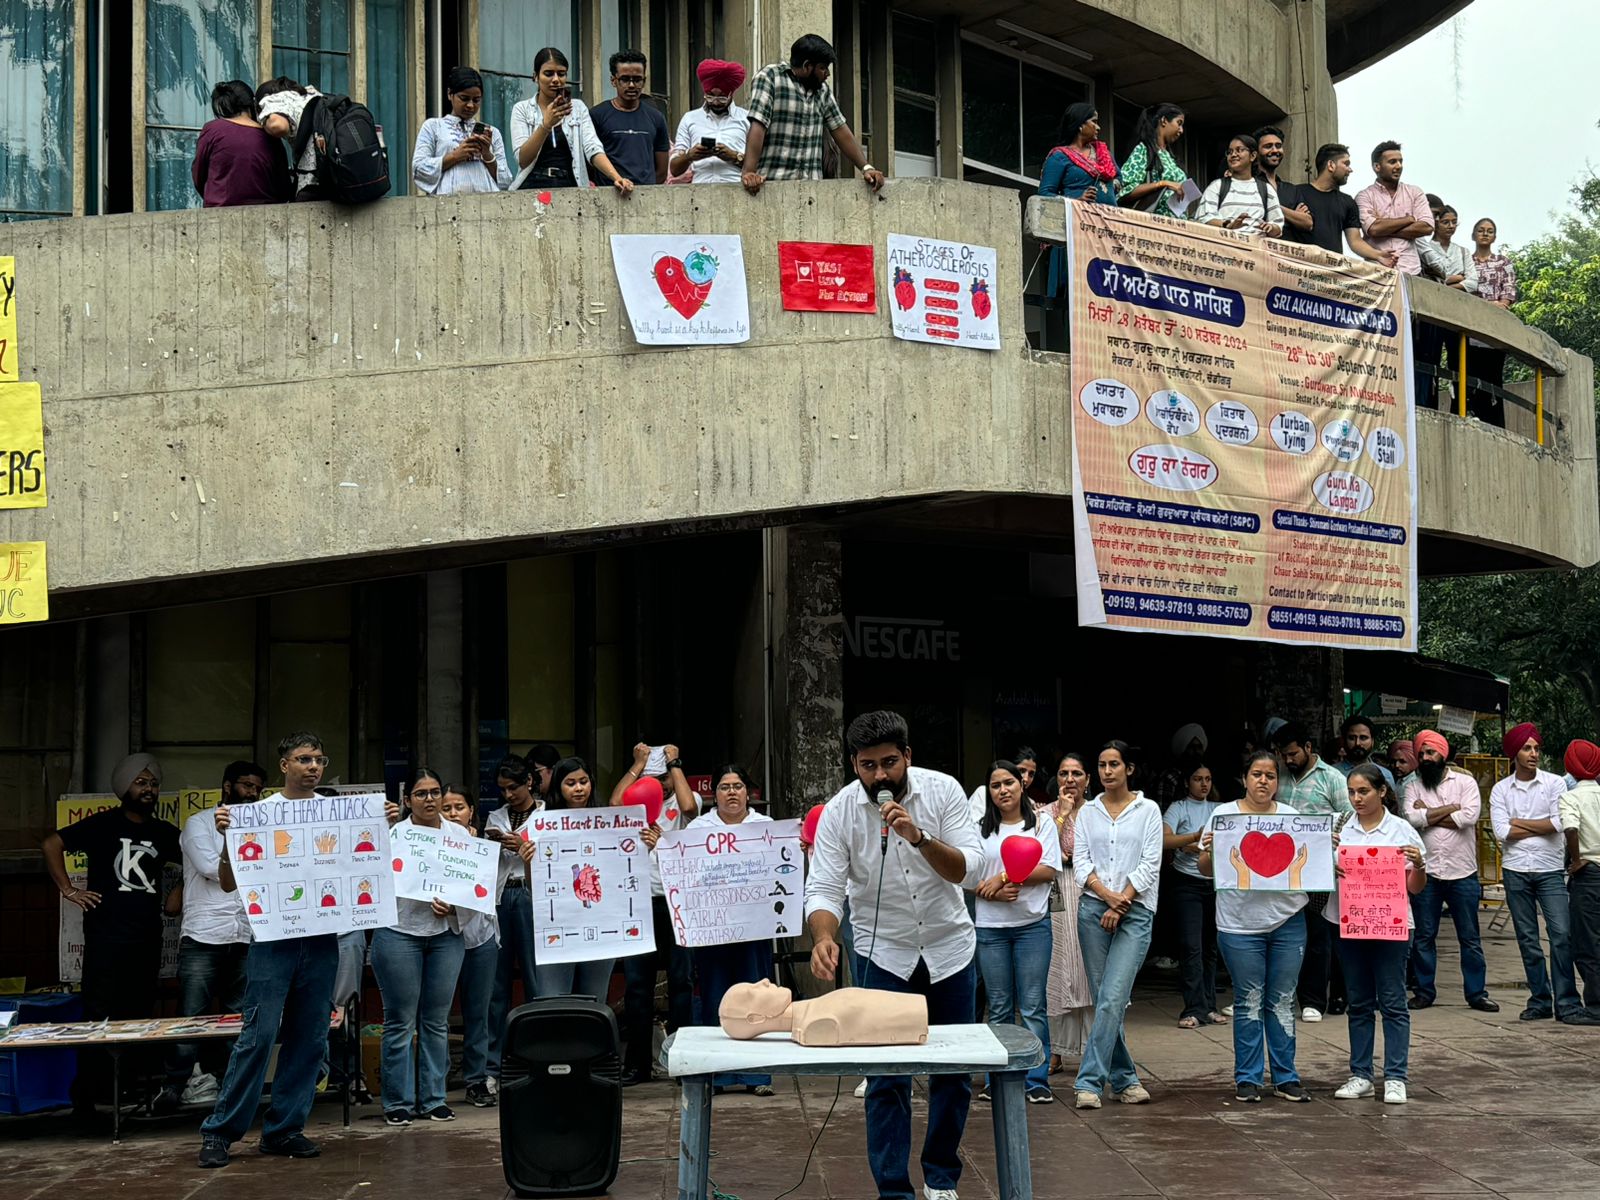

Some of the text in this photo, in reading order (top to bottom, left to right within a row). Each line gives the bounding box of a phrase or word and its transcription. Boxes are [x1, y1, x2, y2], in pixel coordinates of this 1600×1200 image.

[889, 249, 989, 278] ATHEROSCLEROSIS
[1162, 283, 1190, 307] ਪਾਠ
[1192, 287, 1233, 318] ਸਾਹਿਬ
[1272, 292, 1290, 312] SRI
[1292, 298, 1332, 320] AKHAND
[1180, 324, 1192, 339] 30
[1223, 335, 1248, 351] 2024
[1266, 320, 1287, 336] Giving
[1288, 328, 1297, 337] an
[1306, 350, 1317, 366] to
[1279, 413, 1310, 433] Turban
[1282, 431, 1306, 452] Tying
[1376, 431, 1396, 449] Book
[1161, 458, 1178, 474] ਕਾ
[1377, 448, 1395, 465] Stall
[1326, 472, 1360, 493] Guru Ka
[1230, 514, 1255, 530] (SGPC)
[1269, 585, 1296, 599] Contact
[1298, 590, 1305, 600] to
[1139, 598, 1248, 620] 94639-97819, 98885-57630
[274, 802, 289, 826] OF
[293, 799, 326, 823] HEART
[330, 797, 372, 821] ATTACK
[534, 814, 644, 830] Use Heart For Action
[1215, 816, 1330, 832] Be Heart Smart
[391, 829, 488, 856] A STRONG HEART IS
[409, 844, 424, 857] THE
[706, 832, 740, 854] CPR
[418, 862, 475, 881] OF STRONG
